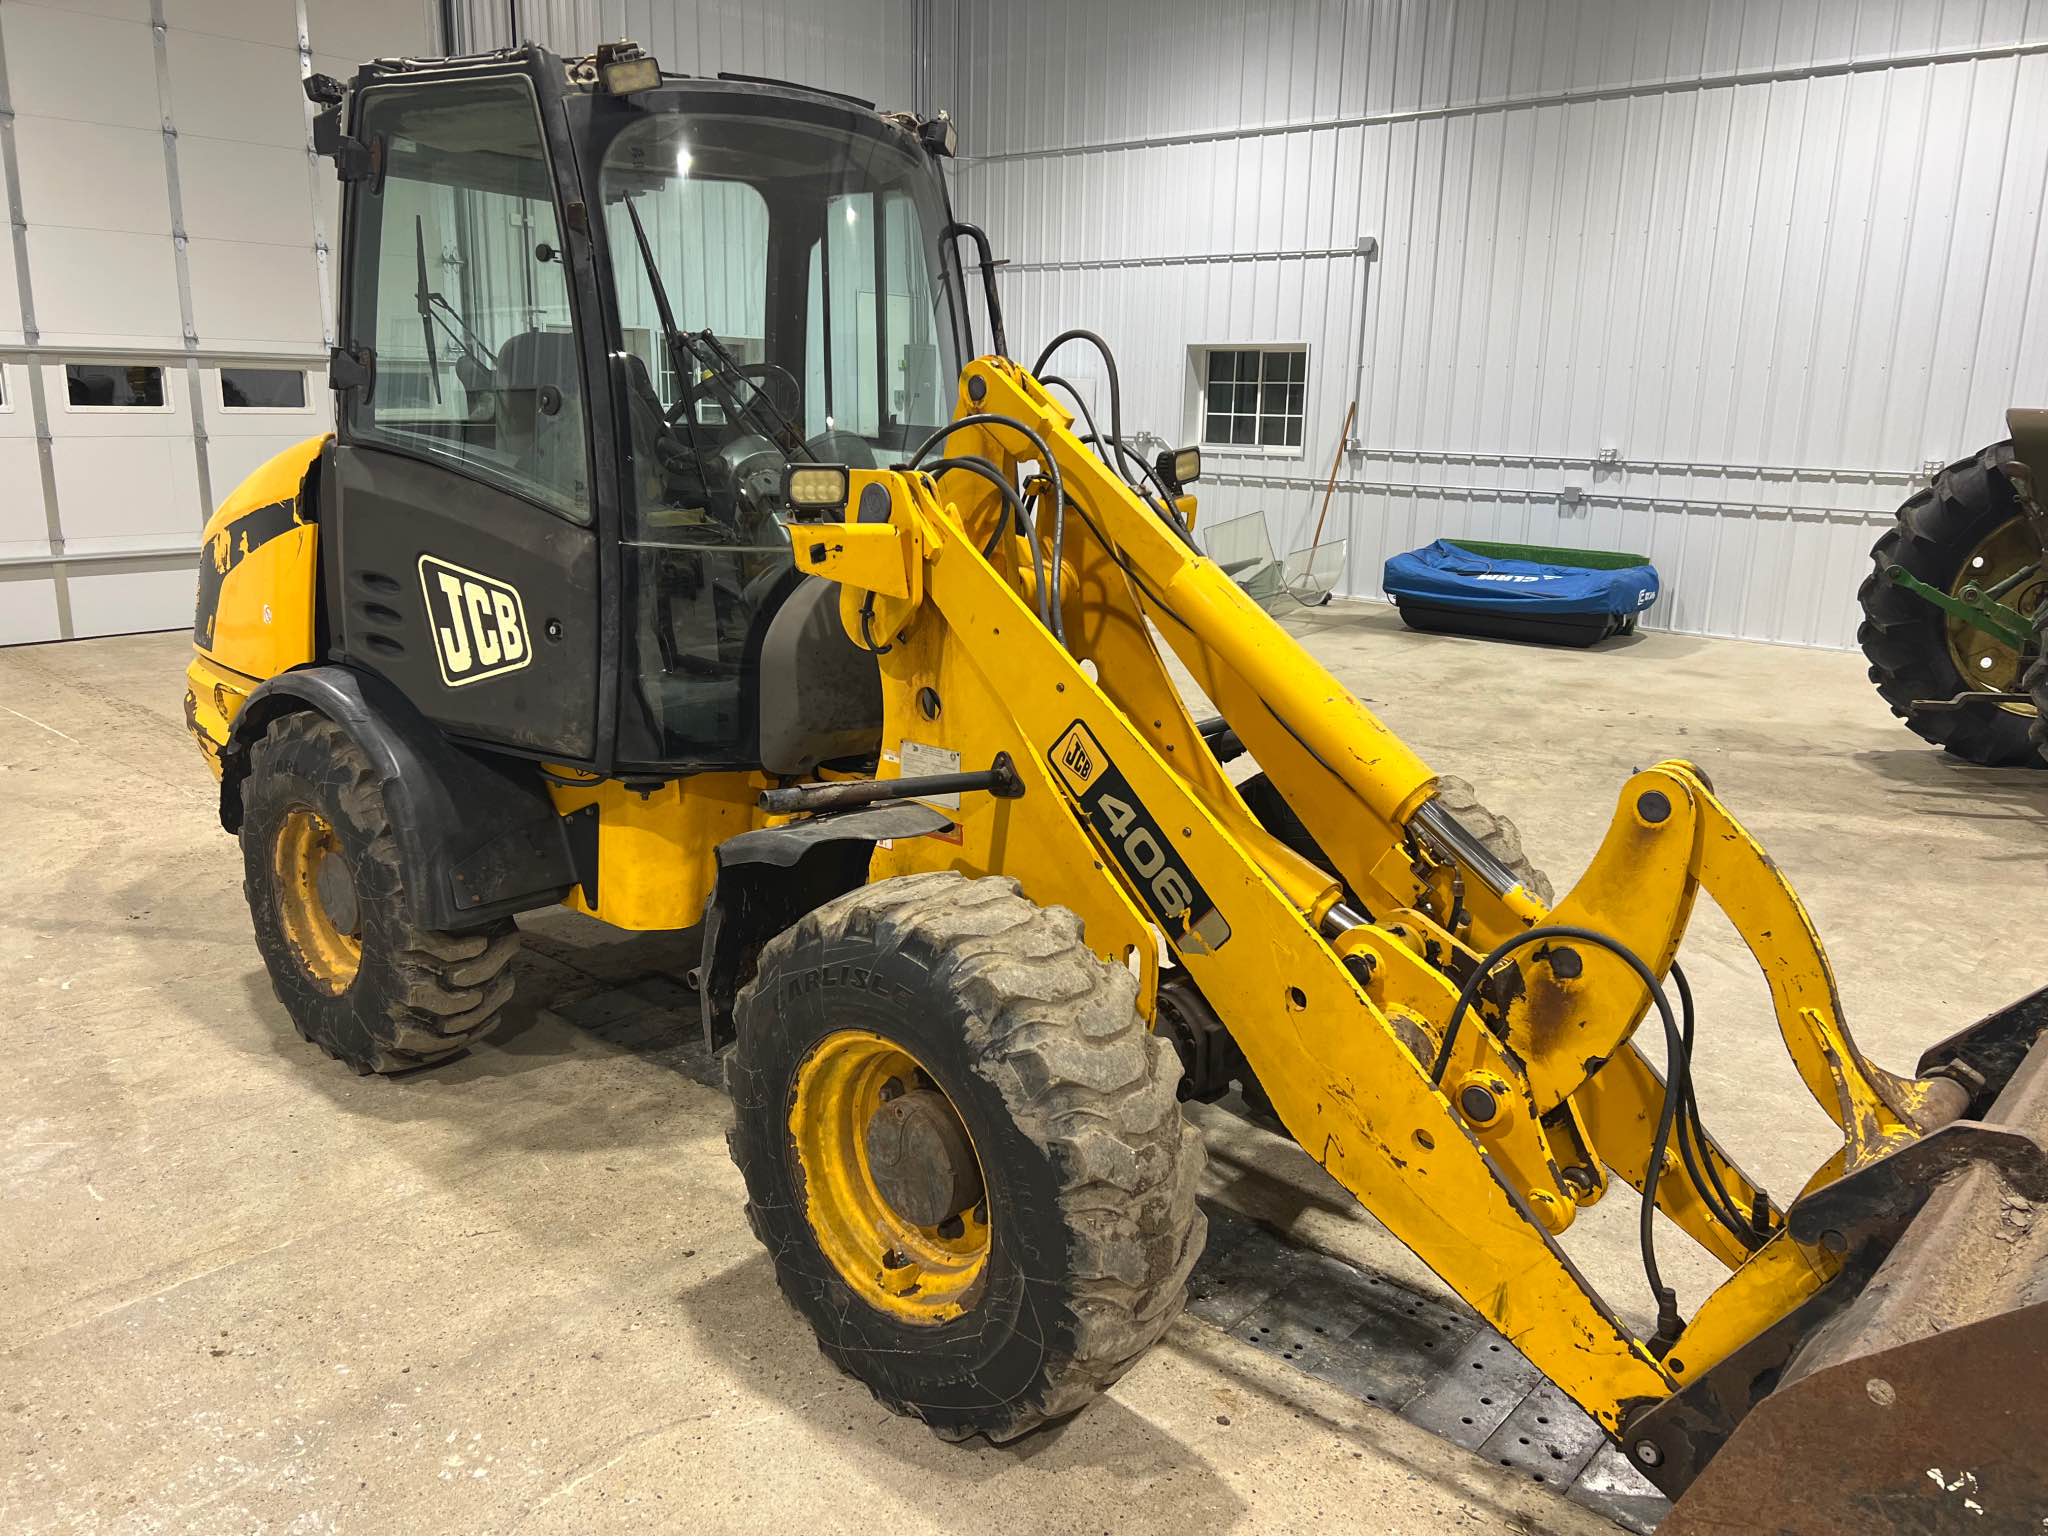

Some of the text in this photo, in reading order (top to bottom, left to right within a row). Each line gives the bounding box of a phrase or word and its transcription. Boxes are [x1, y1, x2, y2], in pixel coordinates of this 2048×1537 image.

[438, 571, 524, 673] JCB
[1066, 741, 1092, 779] JCB
[1097, 794, 1193, 917] 406
